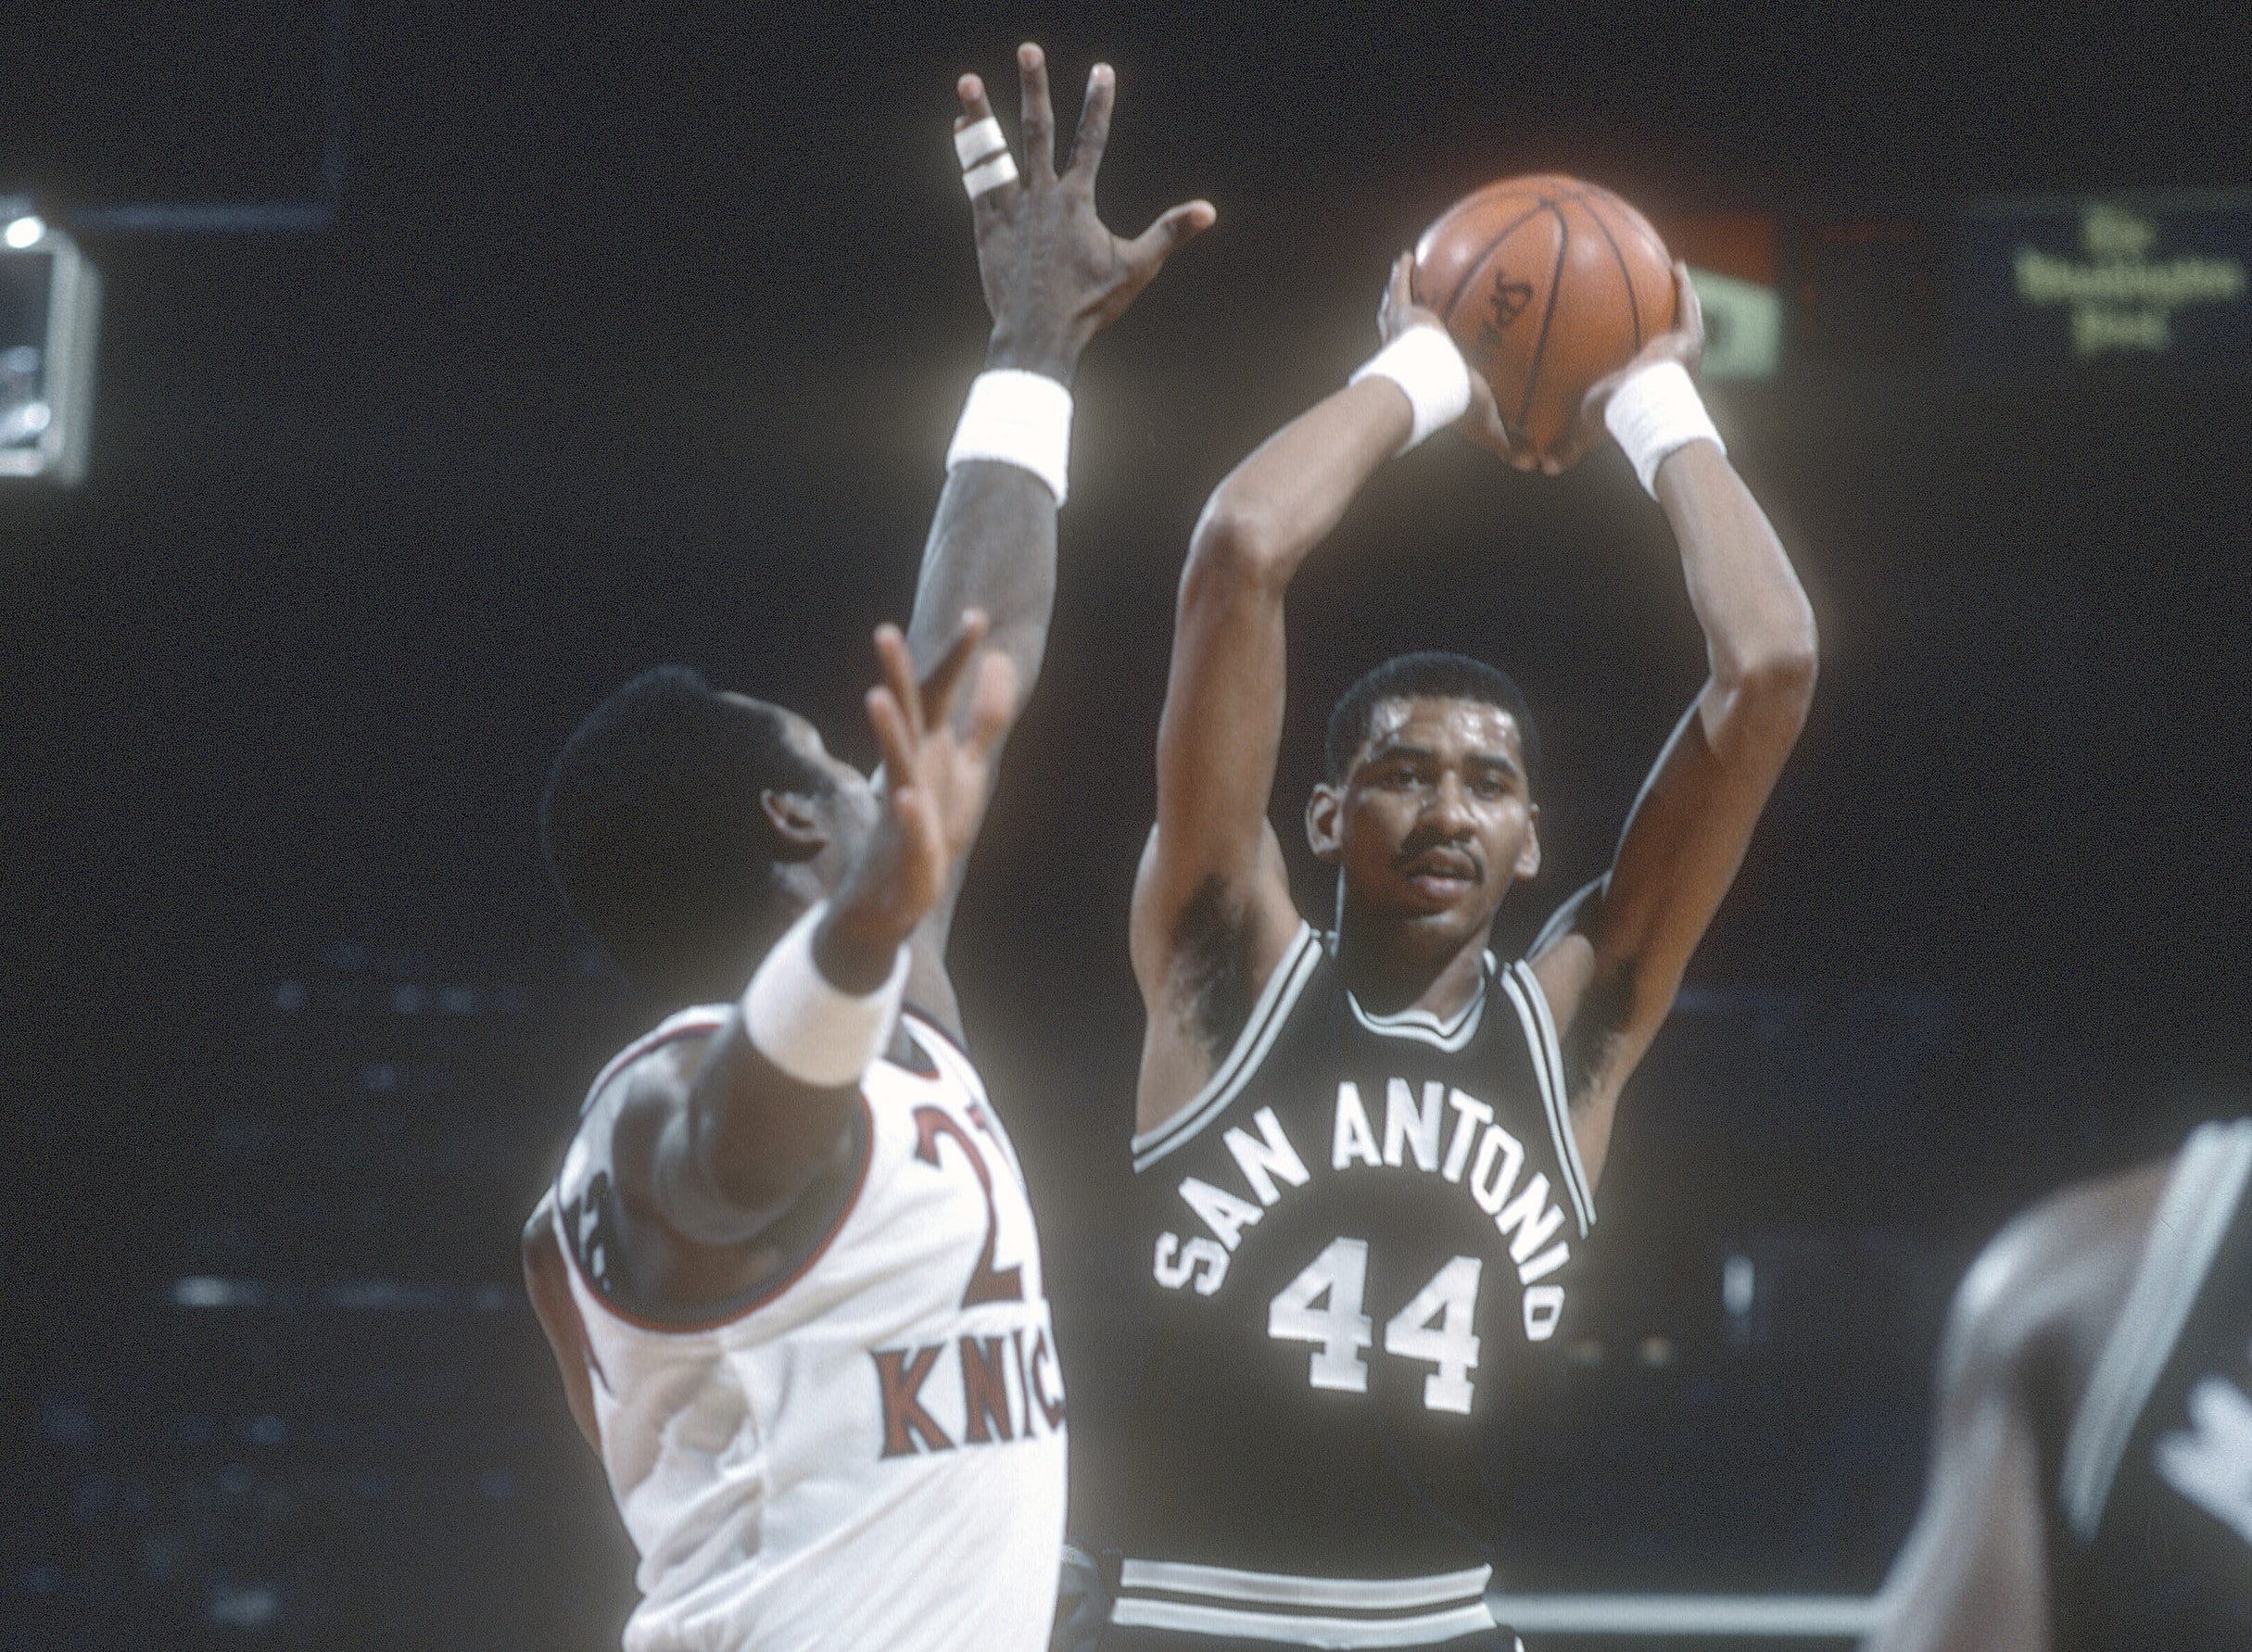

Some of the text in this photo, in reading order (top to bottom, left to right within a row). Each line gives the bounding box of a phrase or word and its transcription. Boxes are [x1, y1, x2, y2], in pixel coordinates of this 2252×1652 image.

[1156, 1078, 1570, 1341] SAN ANTONIO
[1268, 1237, 1482, 1415] 44
